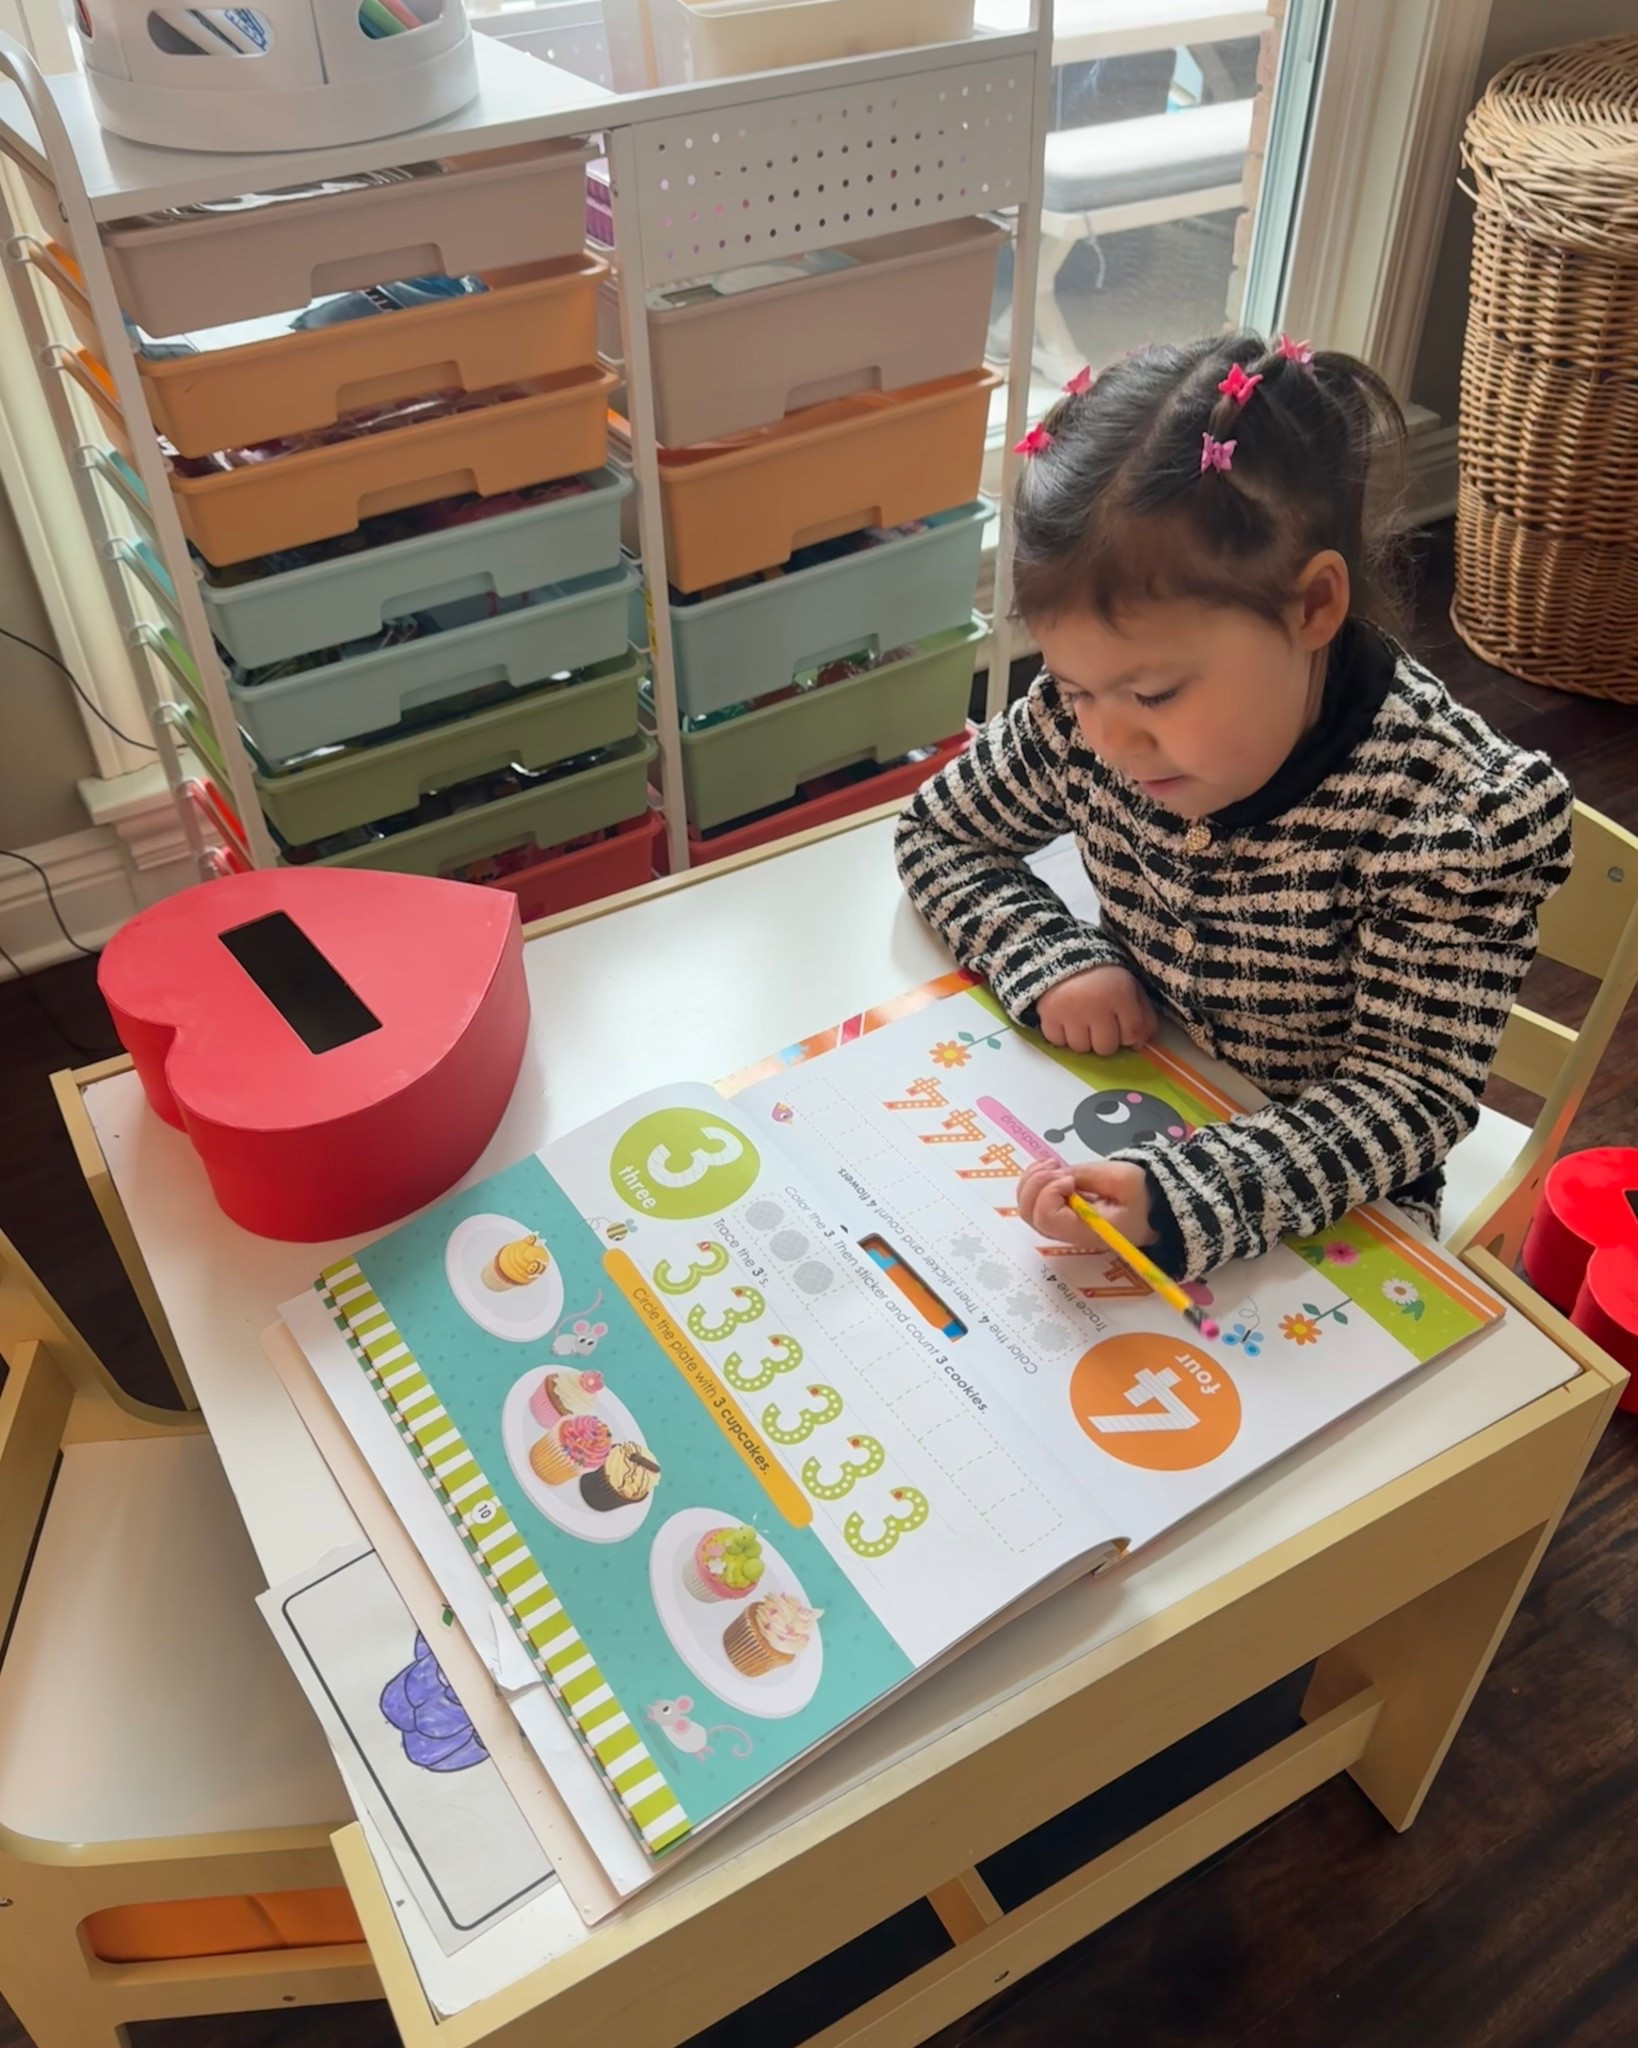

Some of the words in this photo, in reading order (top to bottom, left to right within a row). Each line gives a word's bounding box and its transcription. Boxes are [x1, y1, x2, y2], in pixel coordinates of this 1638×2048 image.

[647, 1126, 743, 1188] 3
[618, 1164, 656, 1209] three
[874, 1207, 904, 1236] count
[713, 1217, 740, 1249] Trace
[737, 1248, 755, 1268] the
[902, 1235, 925, 1257] and
[922, 1255, 956, 1287] sticker
[785, 1186, 811, 1213] Color
[808, 1211, 827, 1231] the
[833, 1240, 858, 1268] Then
[855, 1265, 888, 1300] sticker
[885, 1296, 909, 1323] and
[906, 1321, 940, 1356] count
[935, 1354, 948, 1366] 3
[944, 1366, 988, 1414] cookies.
[953, 1285, 980, 1315] Then
[1057, 1282, 1079, 1306] the
[989, 1322, 1010, 1345] the
[1076, 1301, 1108, 1333] Trace
[1006, 1341, 1038, 1375] Color
[1174, 1353, 1222, 1395] four
[633, 1287, 660, 1321] Circle
[656, 1319, 675, 1341] the
[669, 1341, 697, 1372] plate
[695, 1371, 718, 1399] with
[713, 1397, 726, 1409] 3
[720, 1408, 770, 1475] cupcakes.
[1087, 1367, 1201, 1434] 4
[478, 1504, 492, 1519] 10
